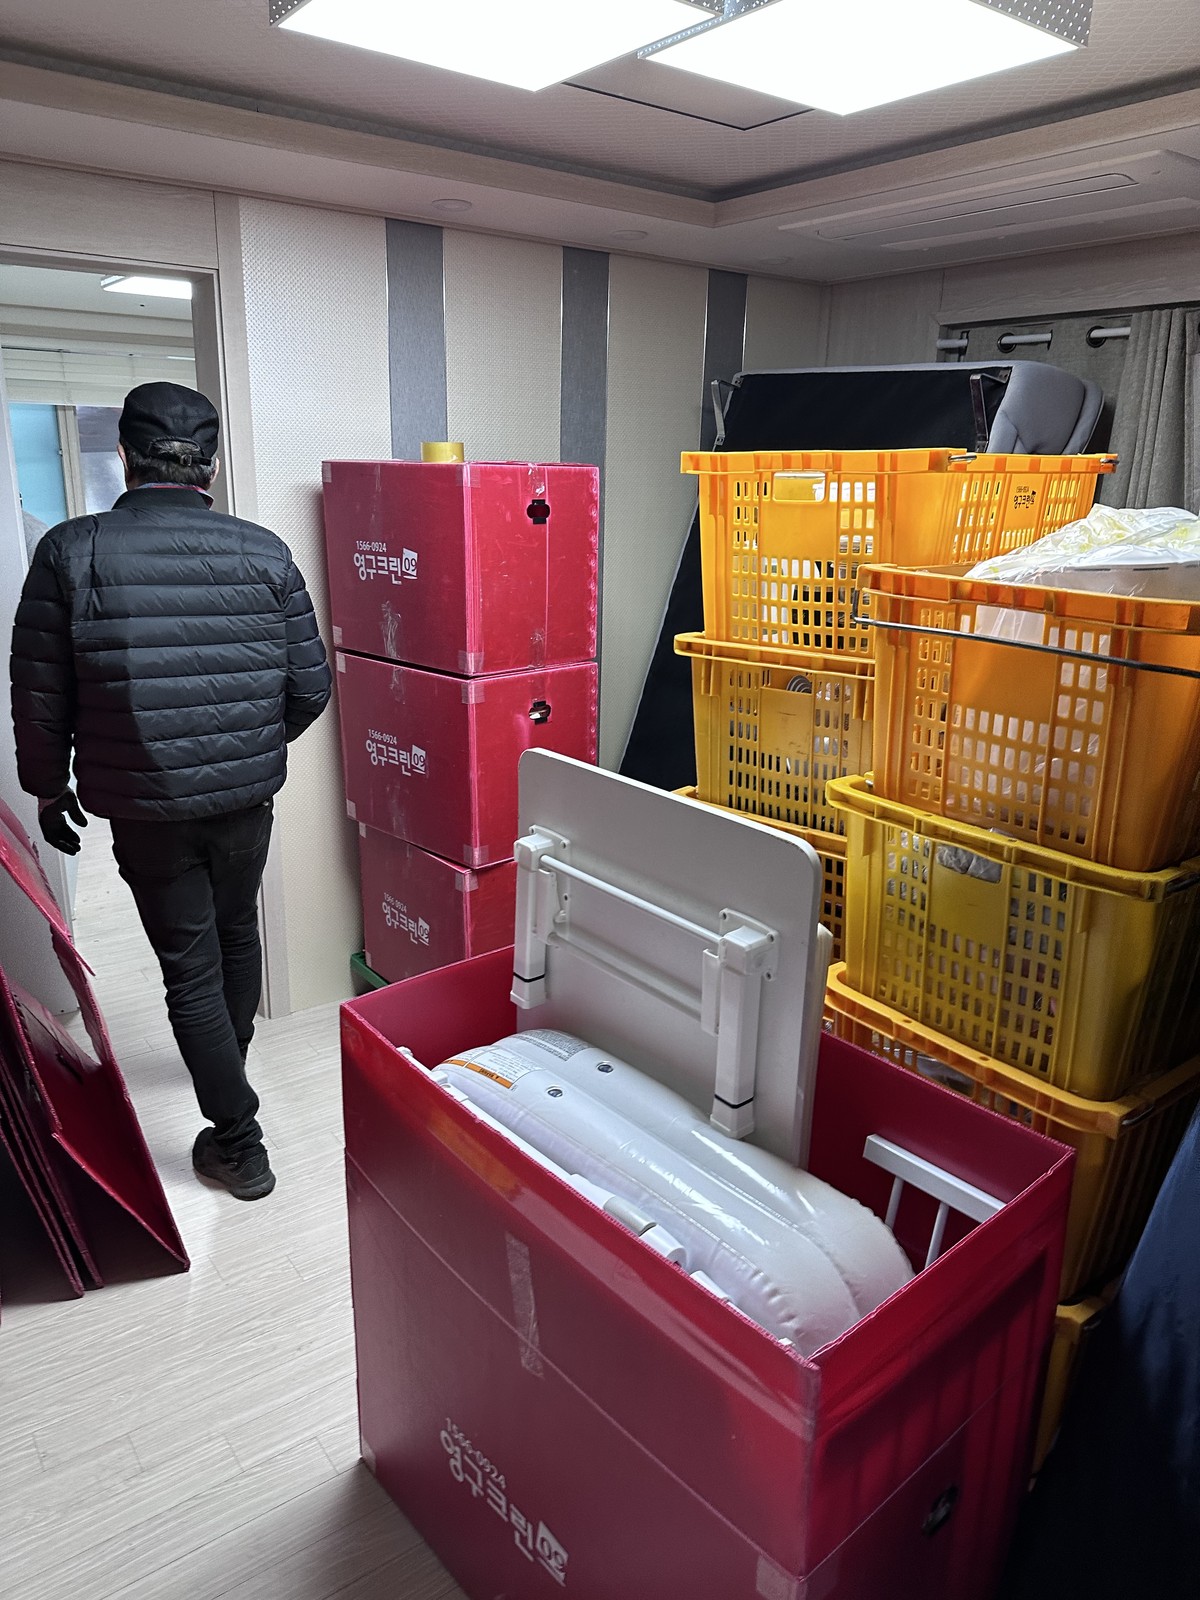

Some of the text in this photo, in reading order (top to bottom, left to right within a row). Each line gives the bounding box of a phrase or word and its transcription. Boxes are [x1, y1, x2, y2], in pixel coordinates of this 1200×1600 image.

[356, 540, 387, 553] 1566-0924
[353, 552, 402, 585] 영구크린
[368, 728, 398, 745] 1566-0924
[365, 739, 412, 777] 영구크린
[382, 901, 418, 945] 영구크린
[440, 1429, 535, 1562] 영구크린
